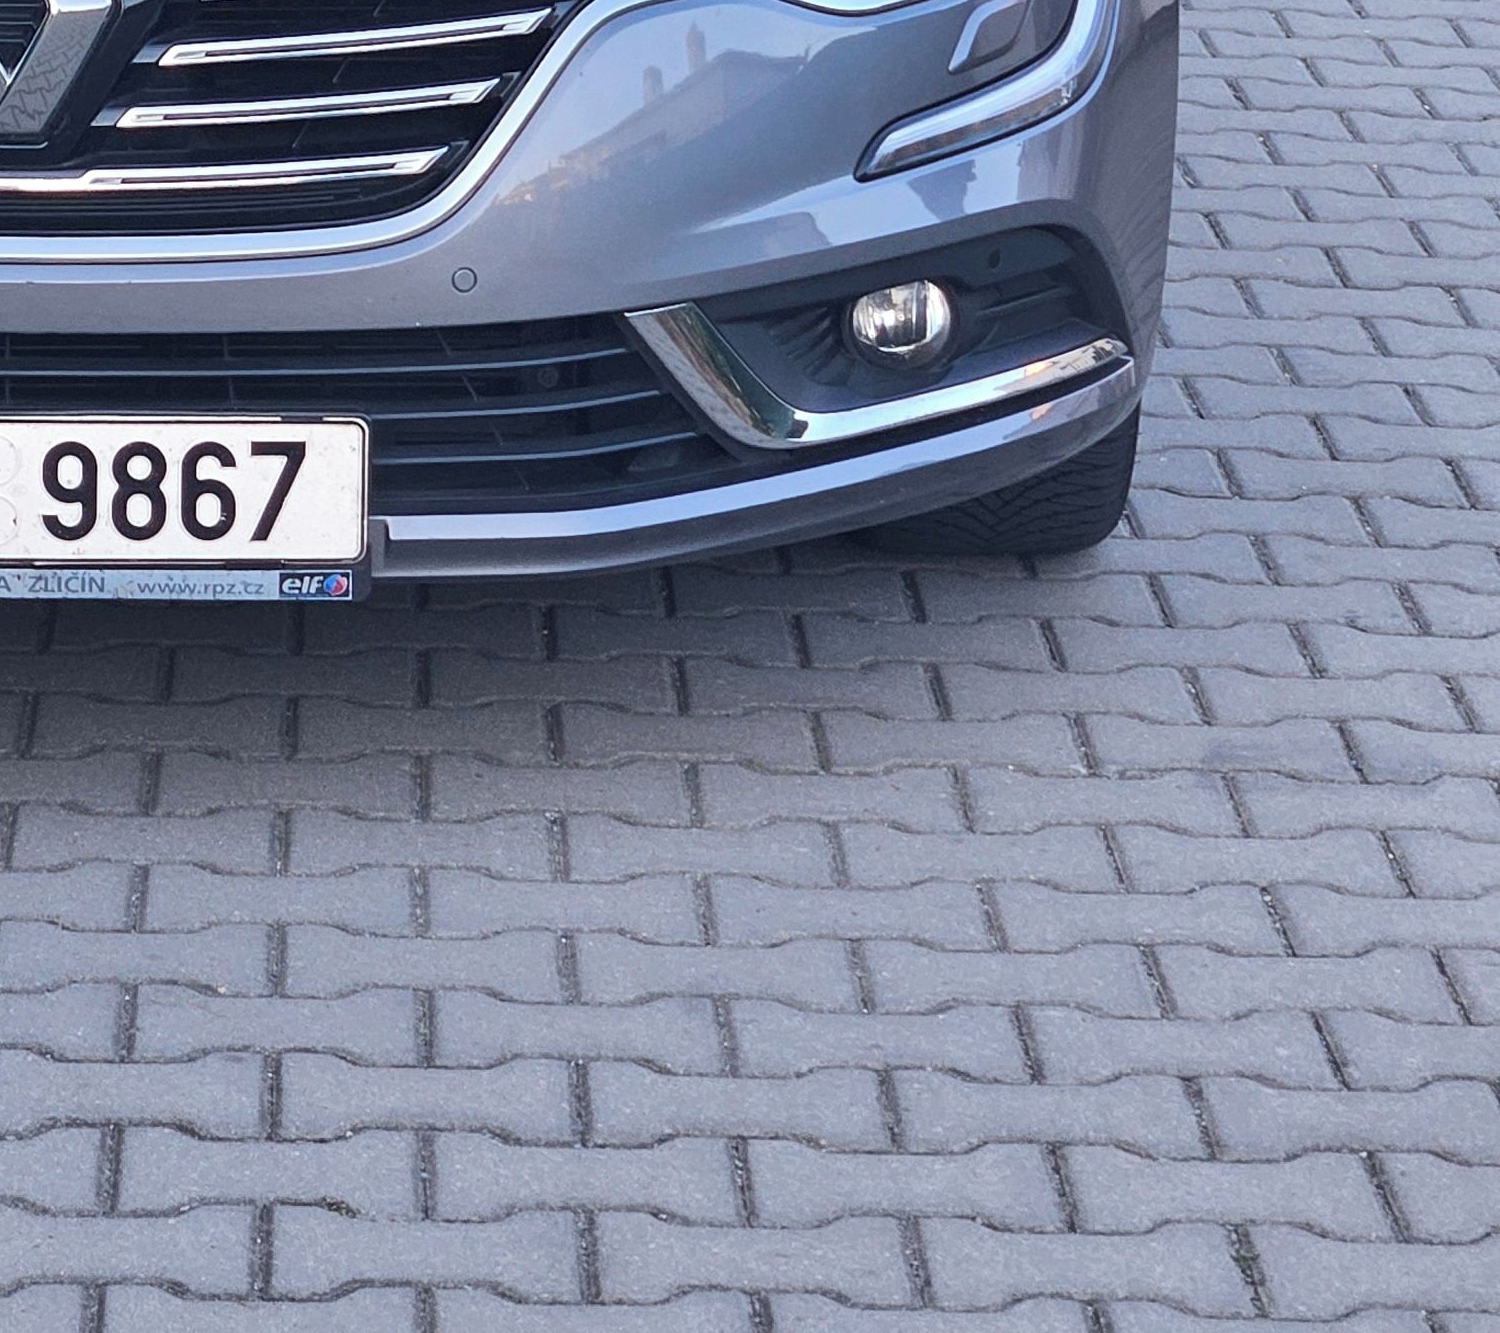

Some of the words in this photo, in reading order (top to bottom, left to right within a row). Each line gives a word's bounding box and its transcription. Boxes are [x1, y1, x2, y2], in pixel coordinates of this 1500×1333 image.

[42, 440, 308, 543] 9867
[137, 581, 265, 598] www.rpz.cz
[281, 574, 323, 597] elf
